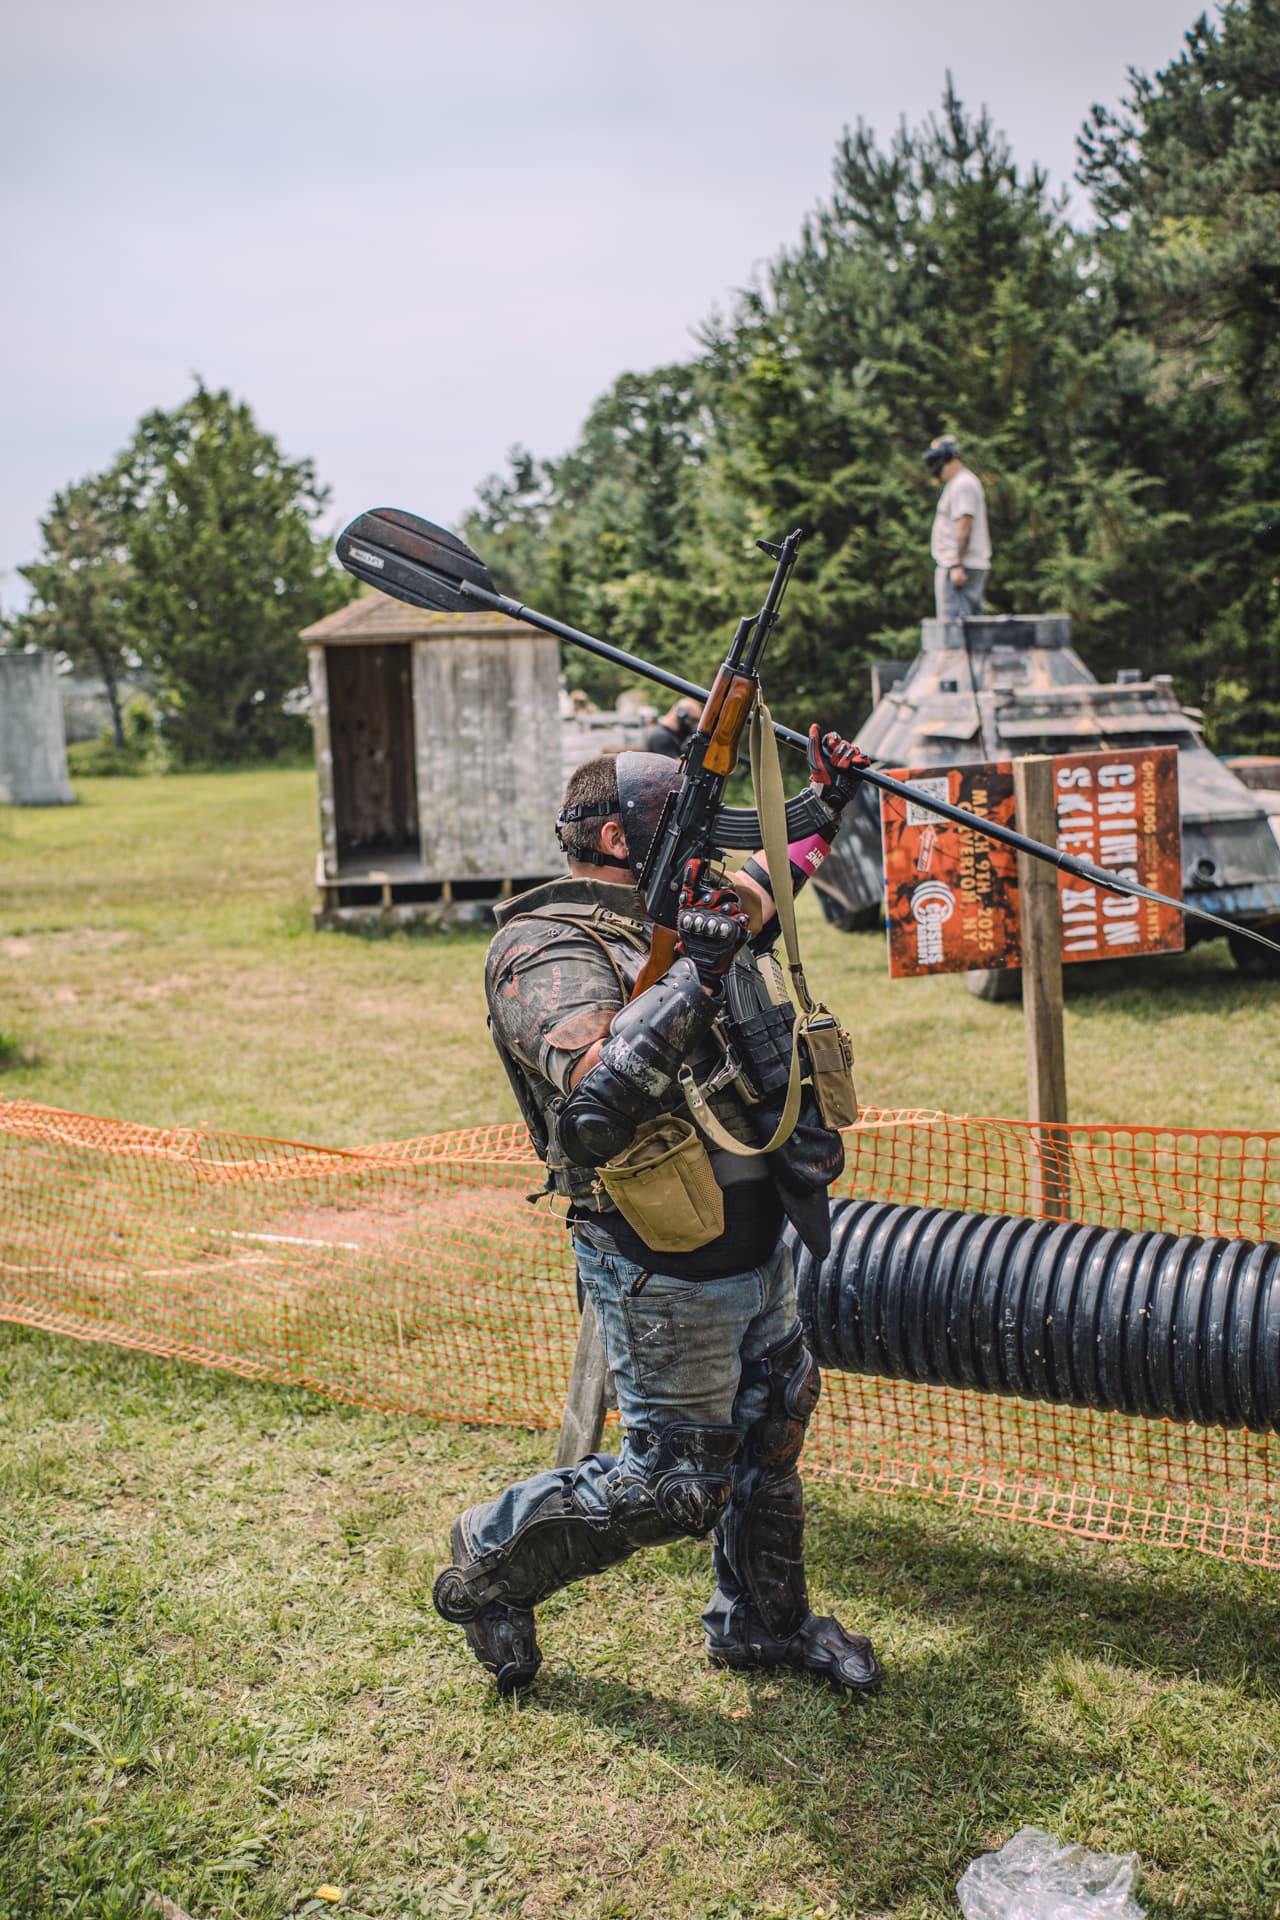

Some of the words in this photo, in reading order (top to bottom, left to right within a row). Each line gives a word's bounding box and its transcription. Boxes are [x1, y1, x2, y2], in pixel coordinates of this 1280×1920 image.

[1141, 761, 1156, 804] GHOST
[971, 789, 991, 853] MACH
[1057, 767, 1094, 867] SKIE
[1143, 805, 1157, 834] DOG
[957, 801, 978, 911] CLVERTON,
[962, 917, 979, 942] NY
[976, 907, 995, 952] 2025
[1061, 887, 1098, 952] XIII
[1146, 872, 1160, 941] PRSENTS
